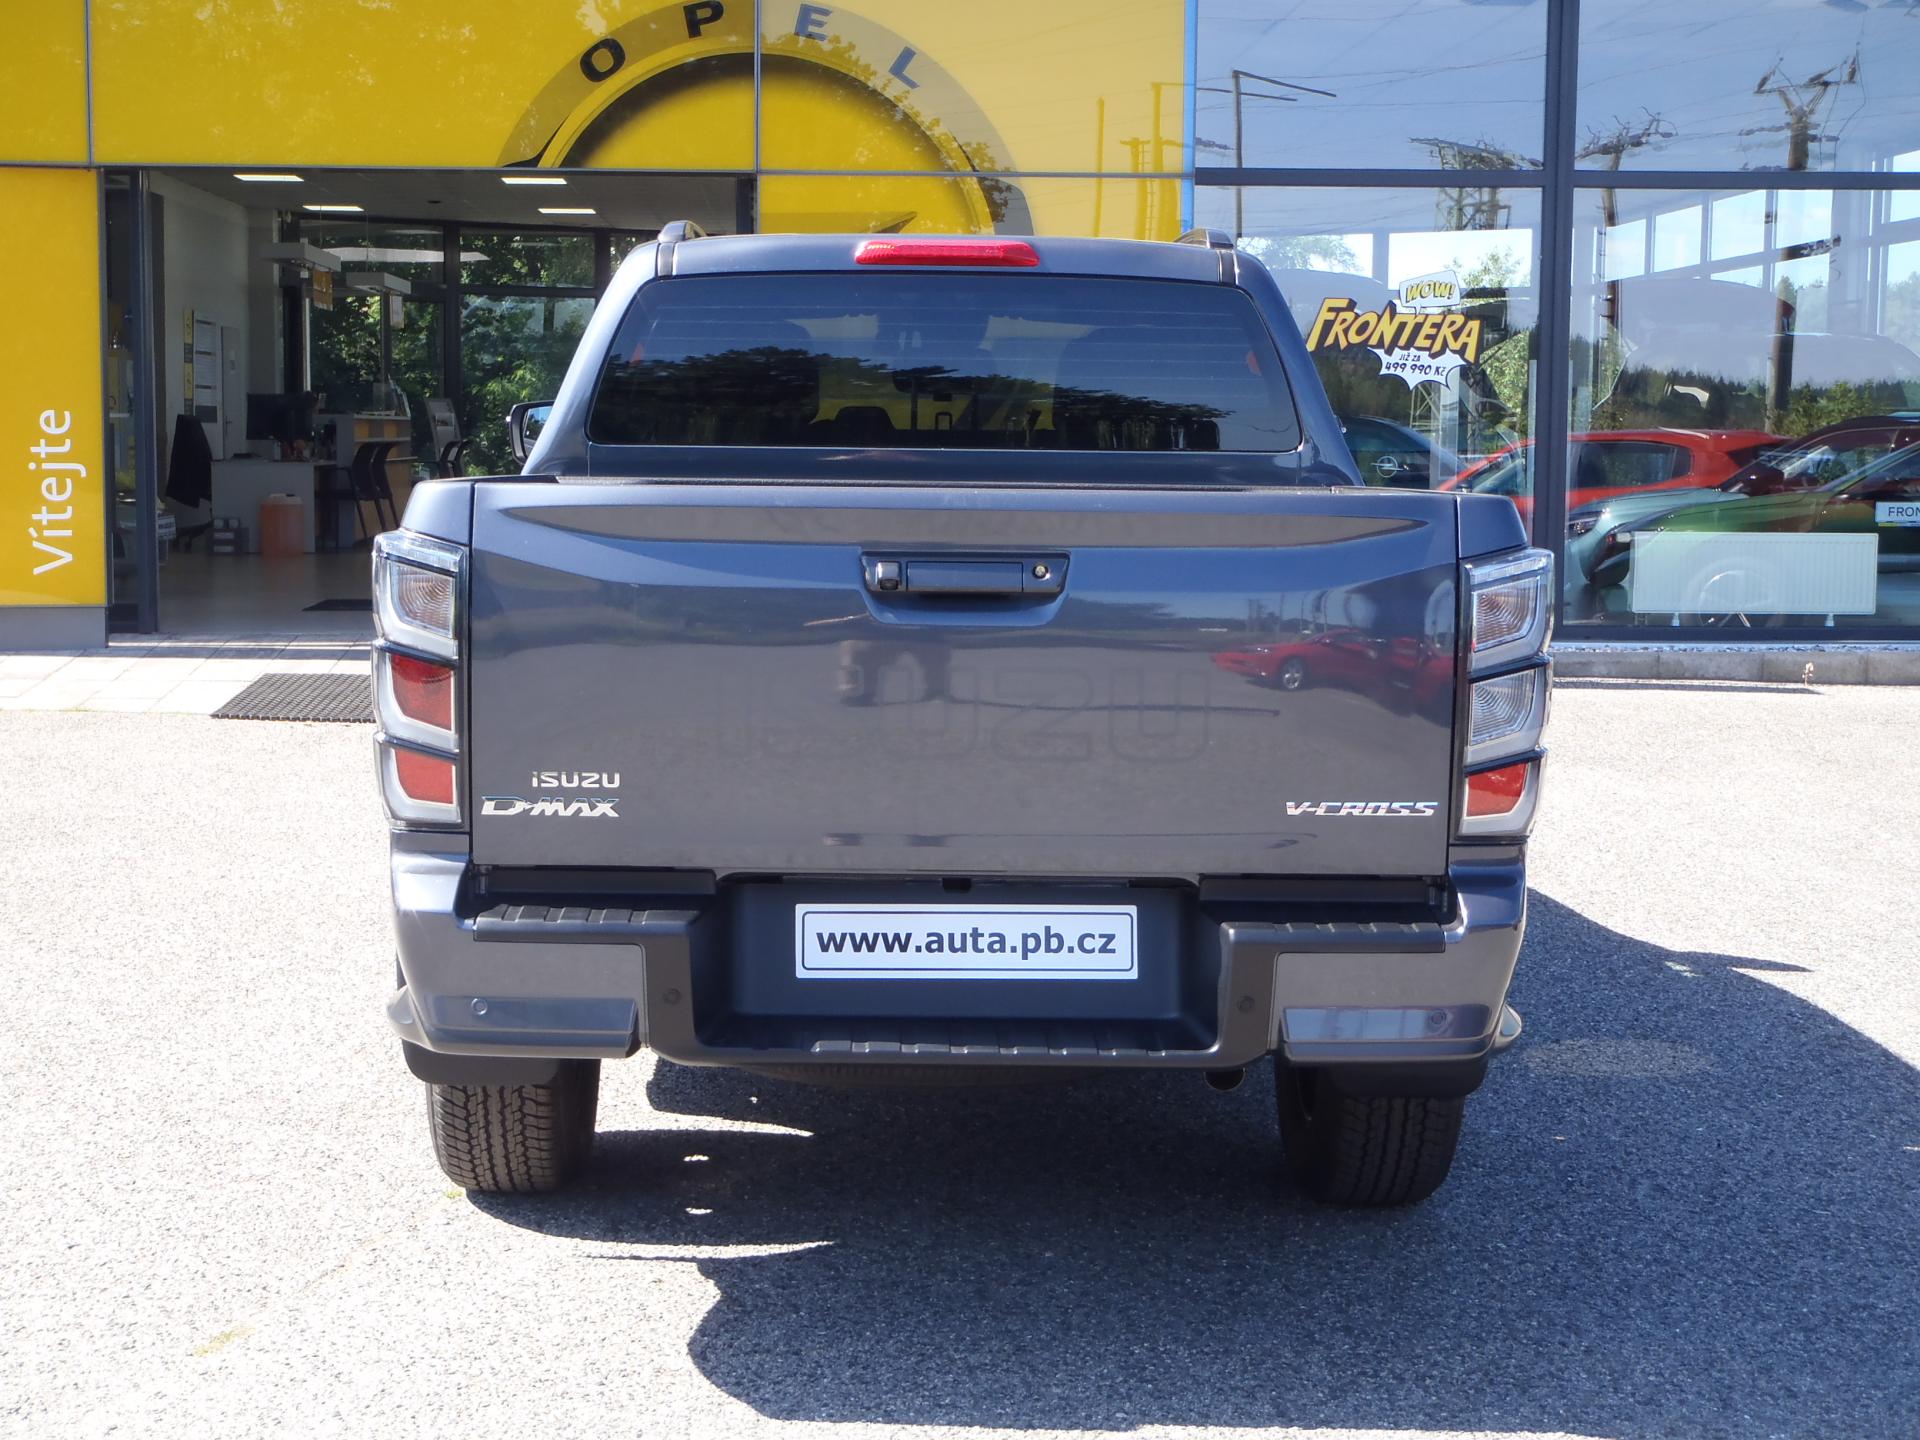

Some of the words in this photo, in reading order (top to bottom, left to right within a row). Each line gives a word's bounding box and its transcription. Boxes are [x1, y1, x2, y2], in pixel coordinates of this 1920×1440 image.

[579, 0, 920, 90] OPEL
[1405, 279, 1456, 303] WOW!
[1306, 297, 1486, 365] FRONTERA
[1385, 361, 1407, 373] 499
[1410, 363, 1432, 375] 990
[28, 409, 87, 576] Vítejte
[481, 796, 620, 818] D-MAX
[1285, 801, 1438, 817] V-CROSS
[816, 926, 1116, 960] www.auta.pb.cz
